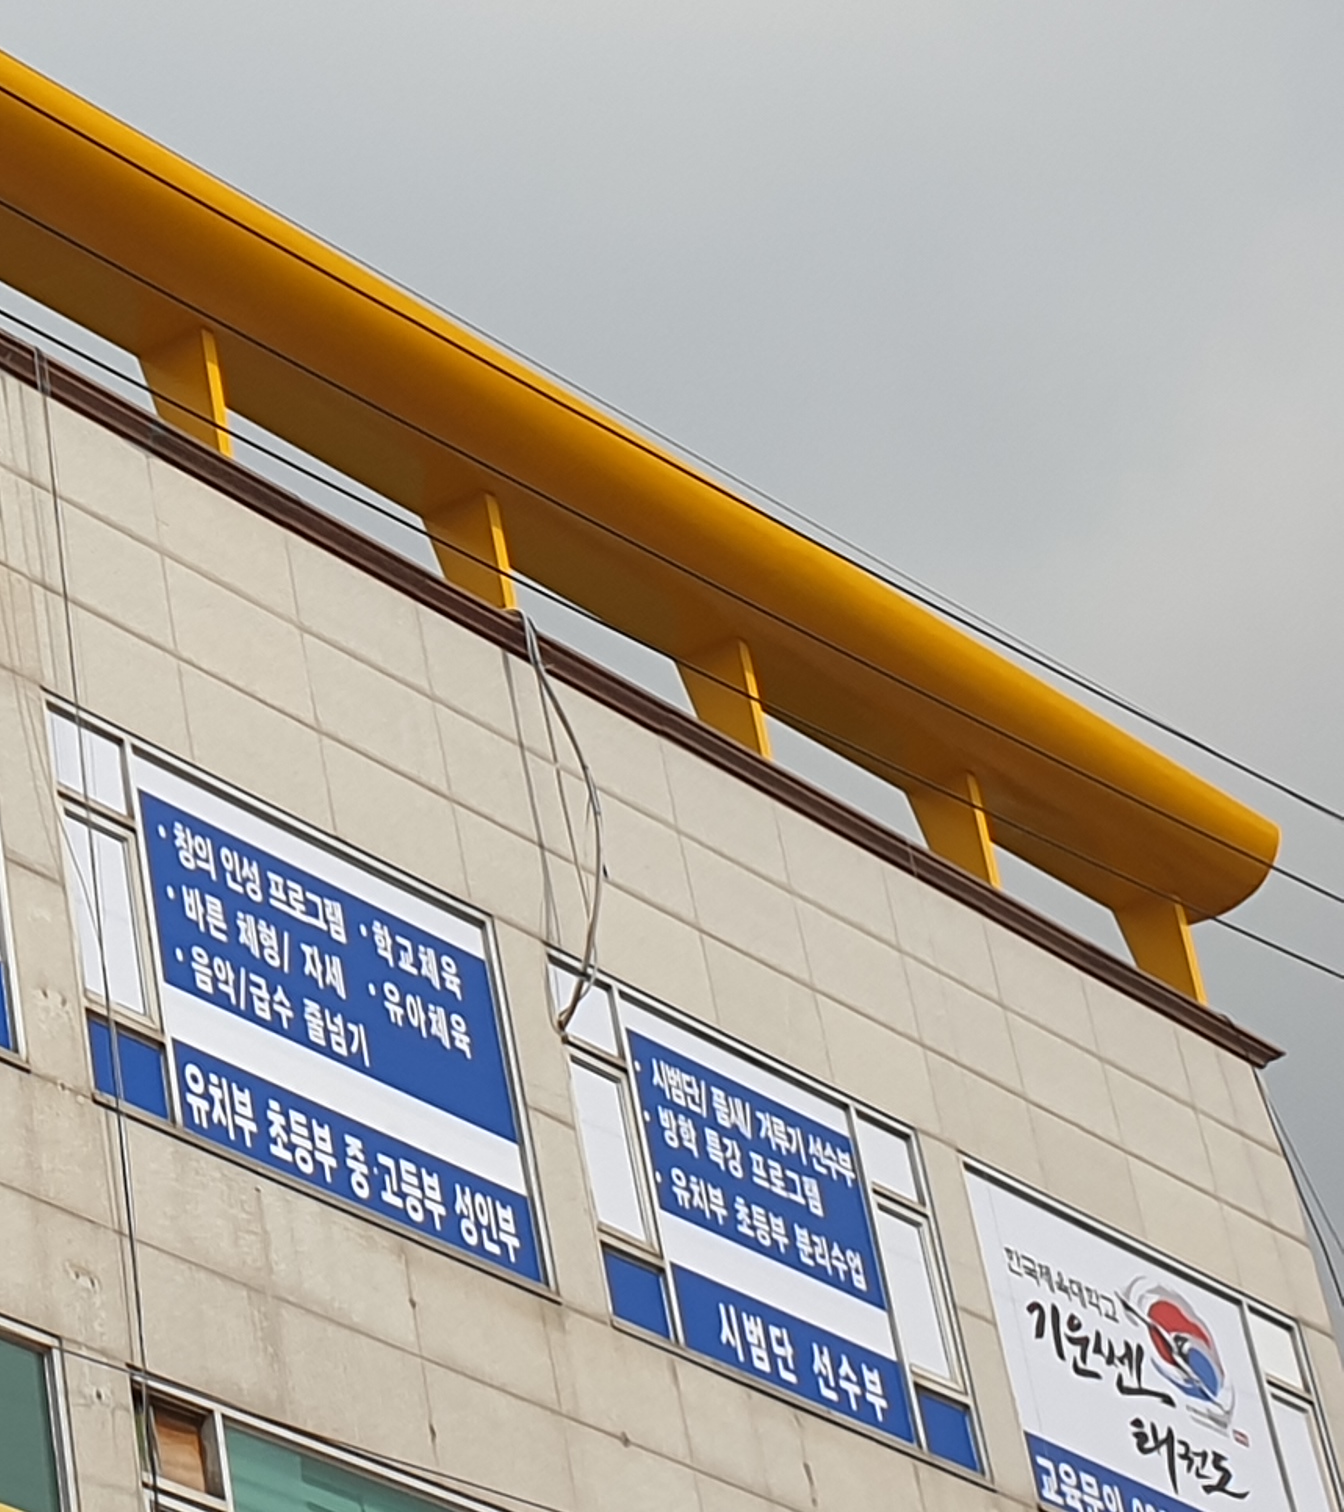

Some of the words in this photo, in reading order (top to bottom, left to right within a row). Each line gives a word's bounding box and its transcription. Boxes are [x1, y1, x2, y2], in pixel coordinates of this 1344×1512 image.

[173, 822, 217, 881] 창의
[220, 846, 263, 903] 인성
[266, 871, 348, 944] 프로그램
[372, 919, 462, 1001] 학교체육
[182, 885, 228, 943] 바른
[300, 943, 348, 1000] 자세
[383, 981, 472, 1059] 유아체육
[302, 998, 370, 1067] 줄넘기
[184, 1062, 258, 1148] 유치부
[266, 1098, 337, 1183] 초등부
[454, 1182, 520, 1263] 성인부
[658, 1105, 699, 1158] 방학
[705, 1127, 744, 1179] 특강
[749, 1151, 825, 1218] 프로그램
[756, 1110, 807, 1166] 겨루기
[808, 1134, 856, 1187] 선수부
[671, 1168, 727, 1226] 유치부
[734, 1196, 789, 1254] 초등부
[794, 1223, 868, 1291] 분리수업
[718, 1303, 798, 1384] 시범단
[812, 1341, 888, 1422] 선수부
